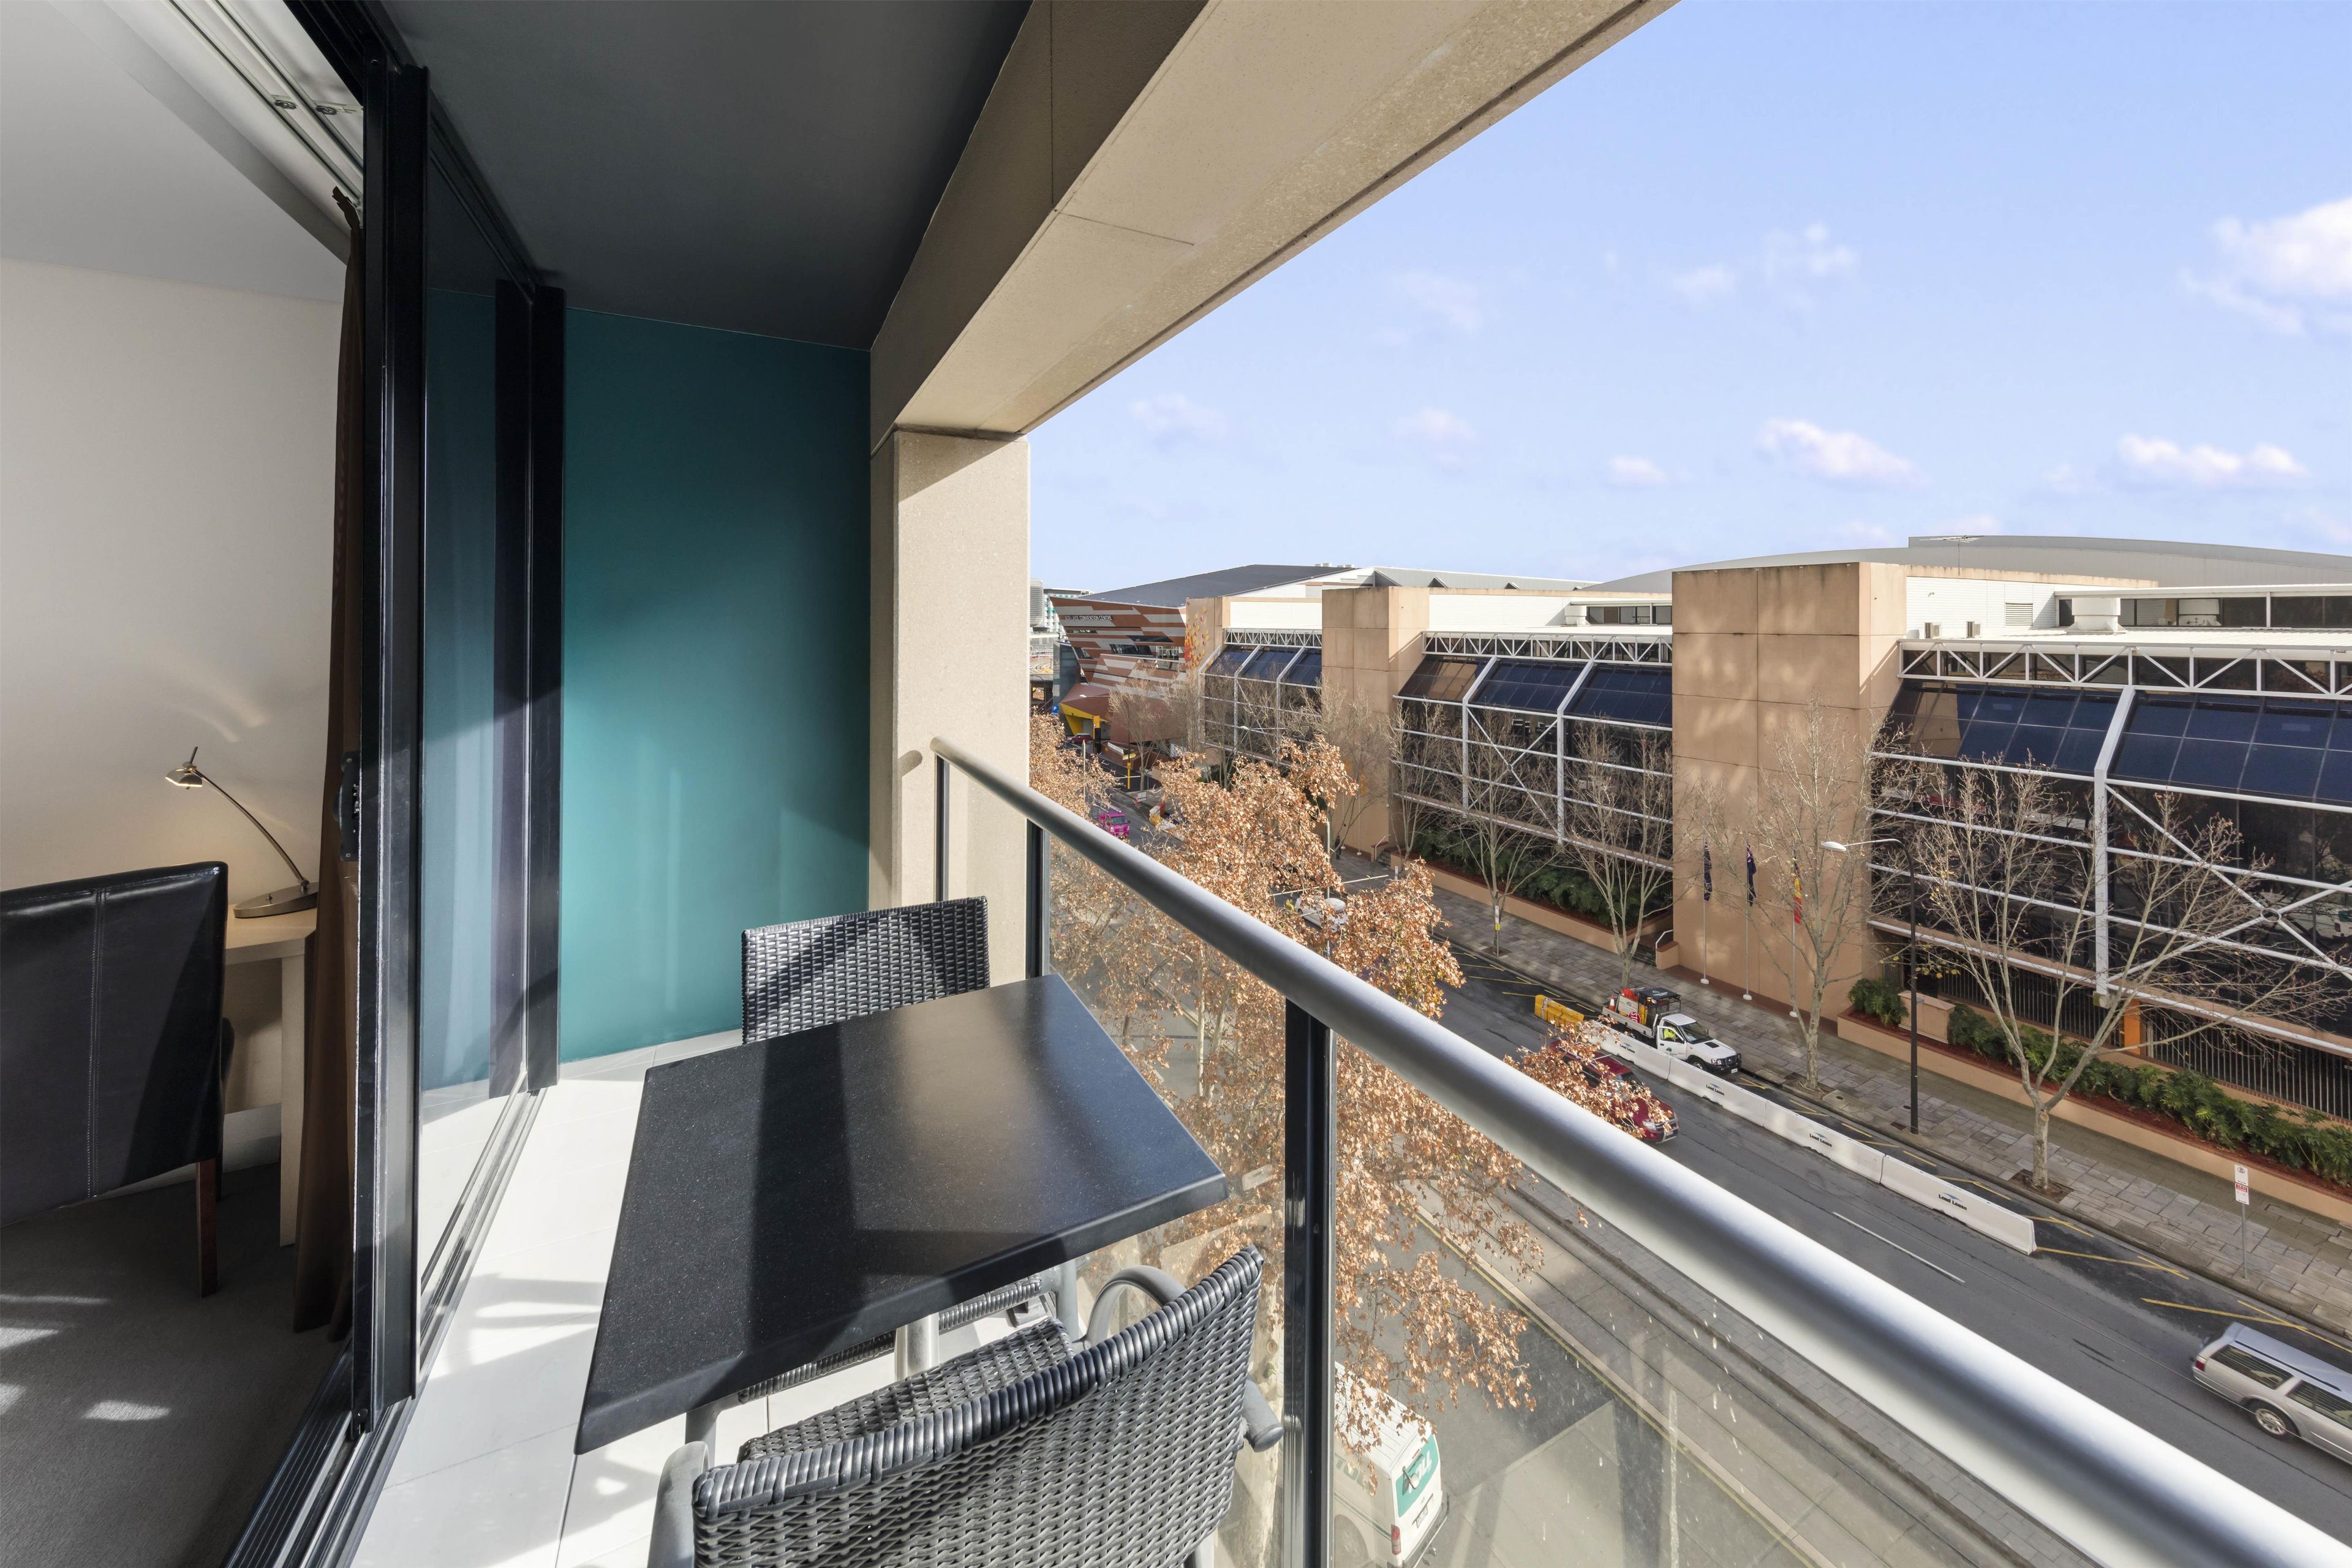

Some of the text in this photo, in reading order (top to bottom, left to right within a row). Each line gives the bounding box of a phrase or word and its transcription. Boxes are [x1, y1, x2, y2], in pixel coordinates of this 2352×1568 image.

[1809, 1133, 1833, 1147] Lend Lease
[1939, 1194, 1967, 1211] Lend Lease
